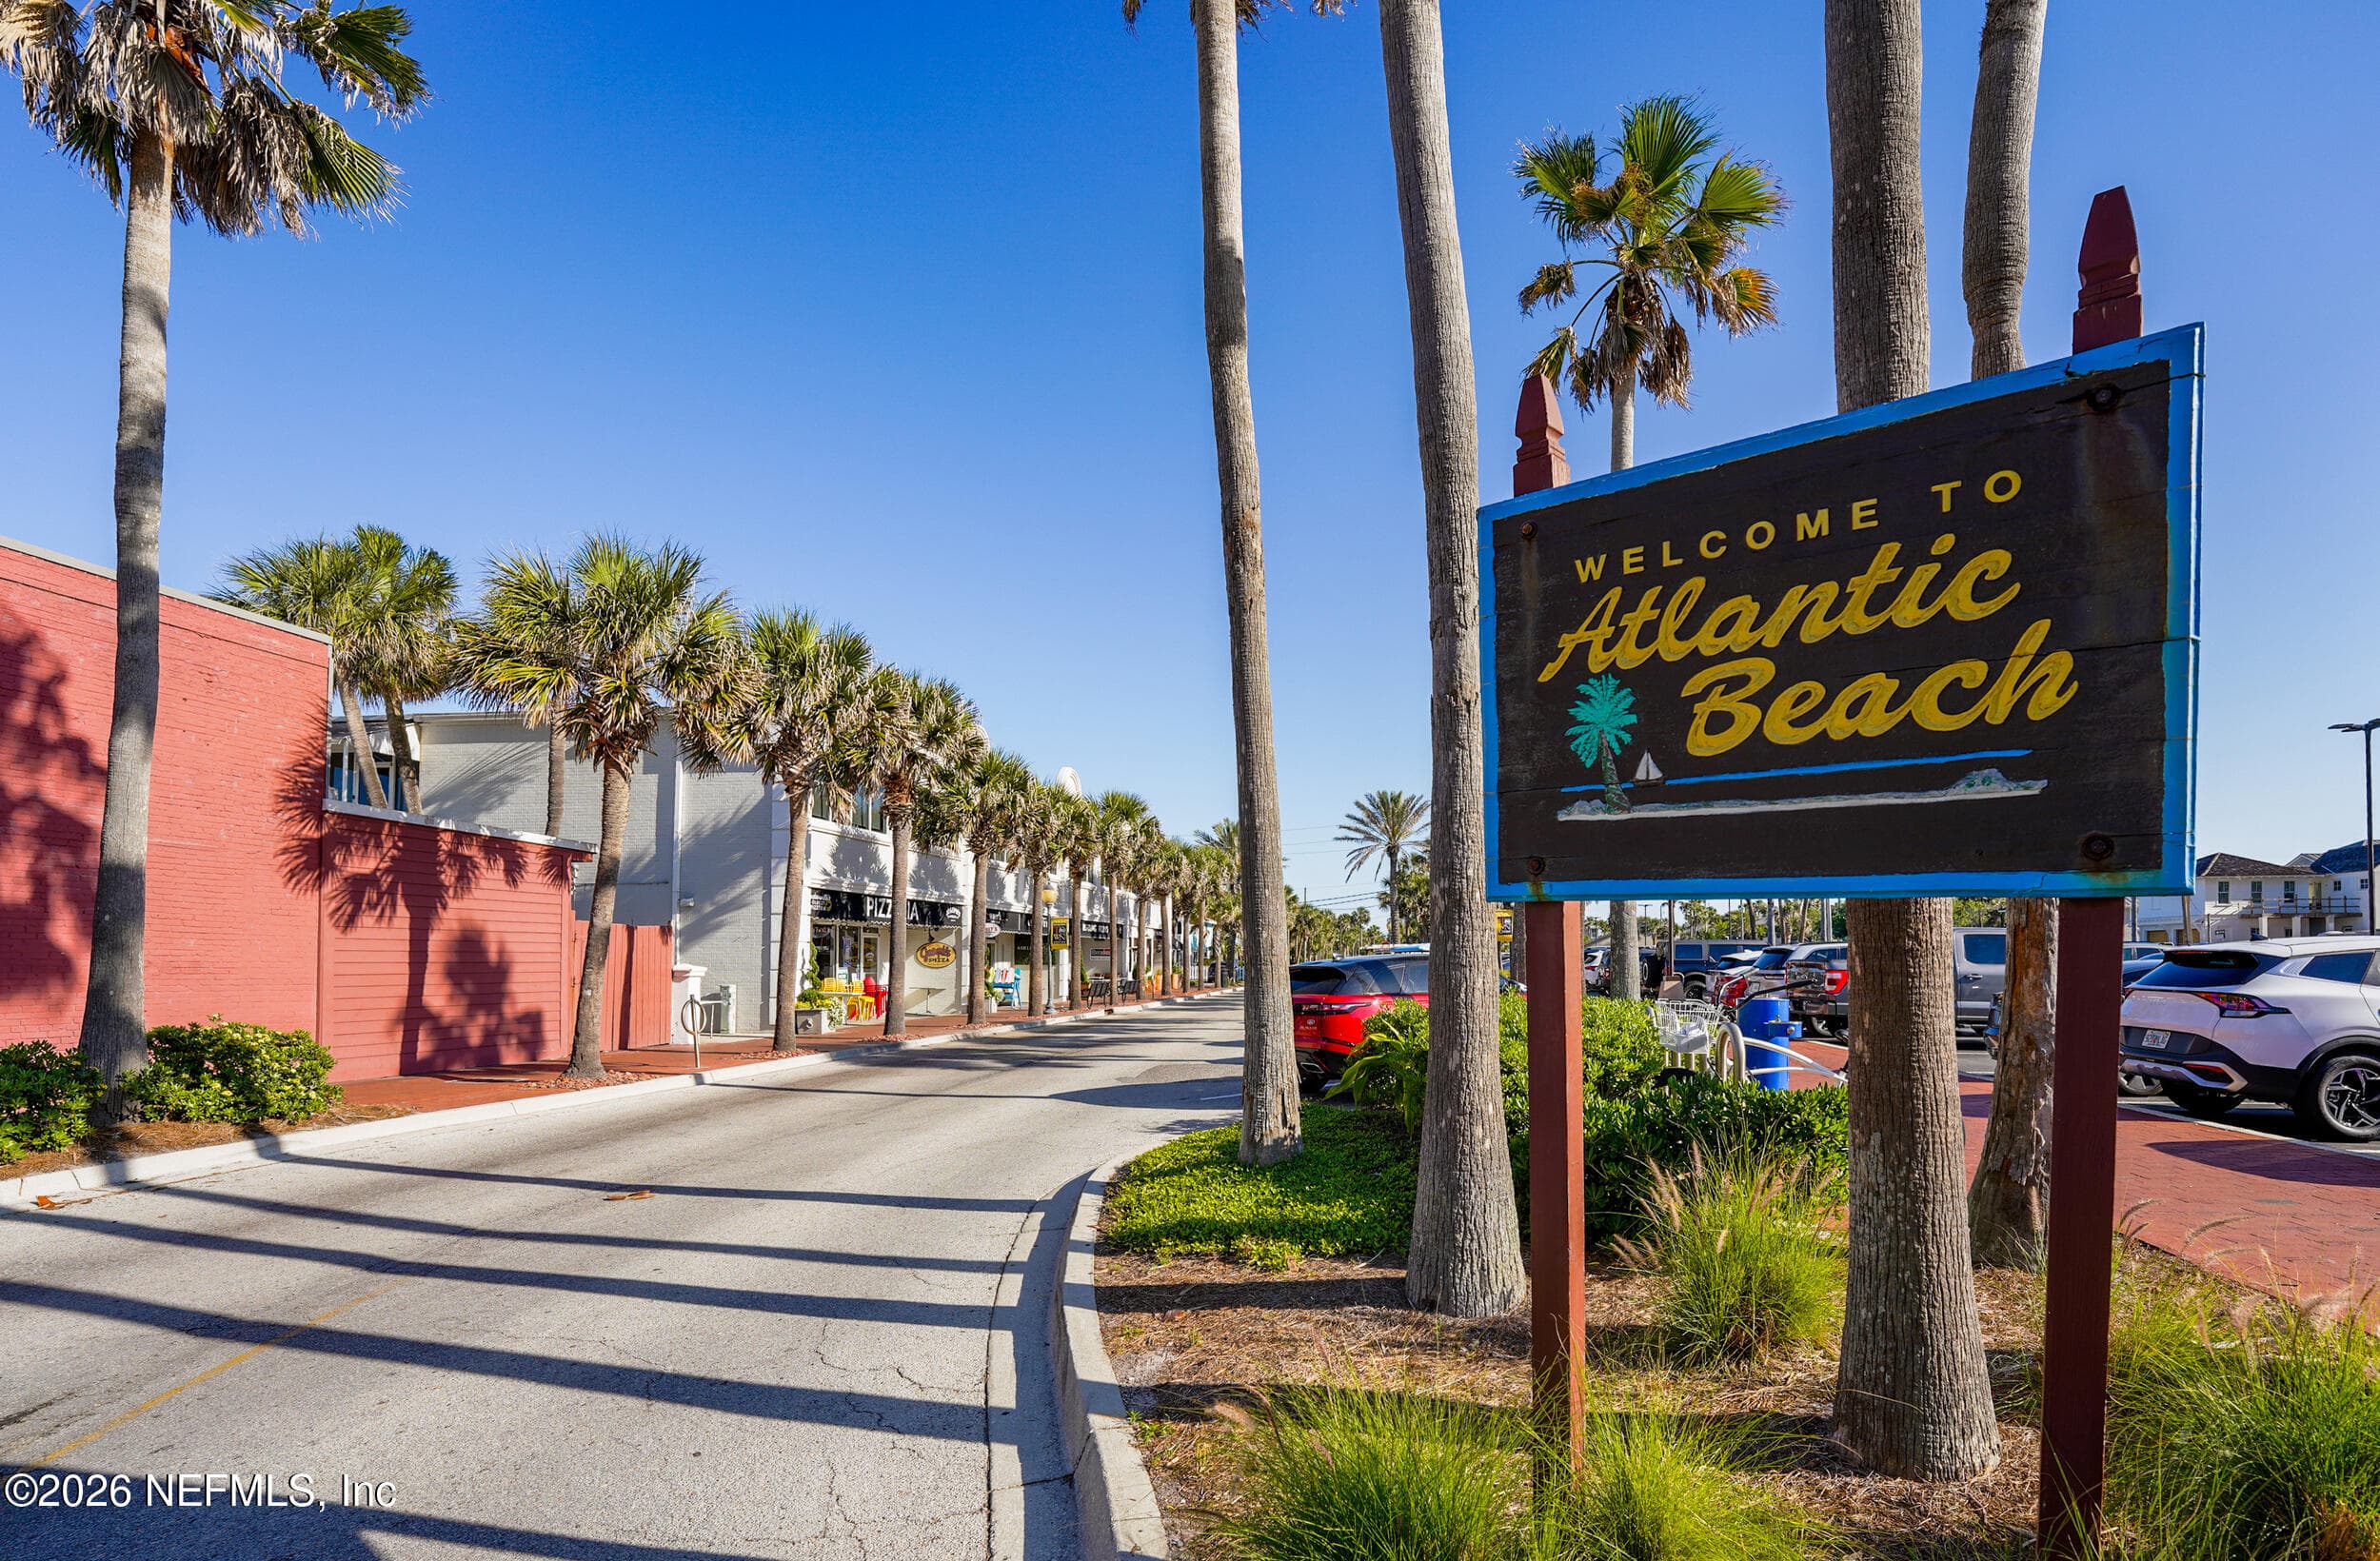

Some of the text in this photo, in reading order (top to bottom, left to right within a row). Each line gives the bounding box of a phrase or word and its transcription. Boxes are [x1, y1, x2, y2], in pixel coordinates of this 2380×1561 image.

[1575, 469, 2024, 583] WELCOME TO
[1536, 532, 2023, 683] Atlantic
[1678, 618, 2080, 758] Beach
[866, 897, 920, 921] PIZZIA
